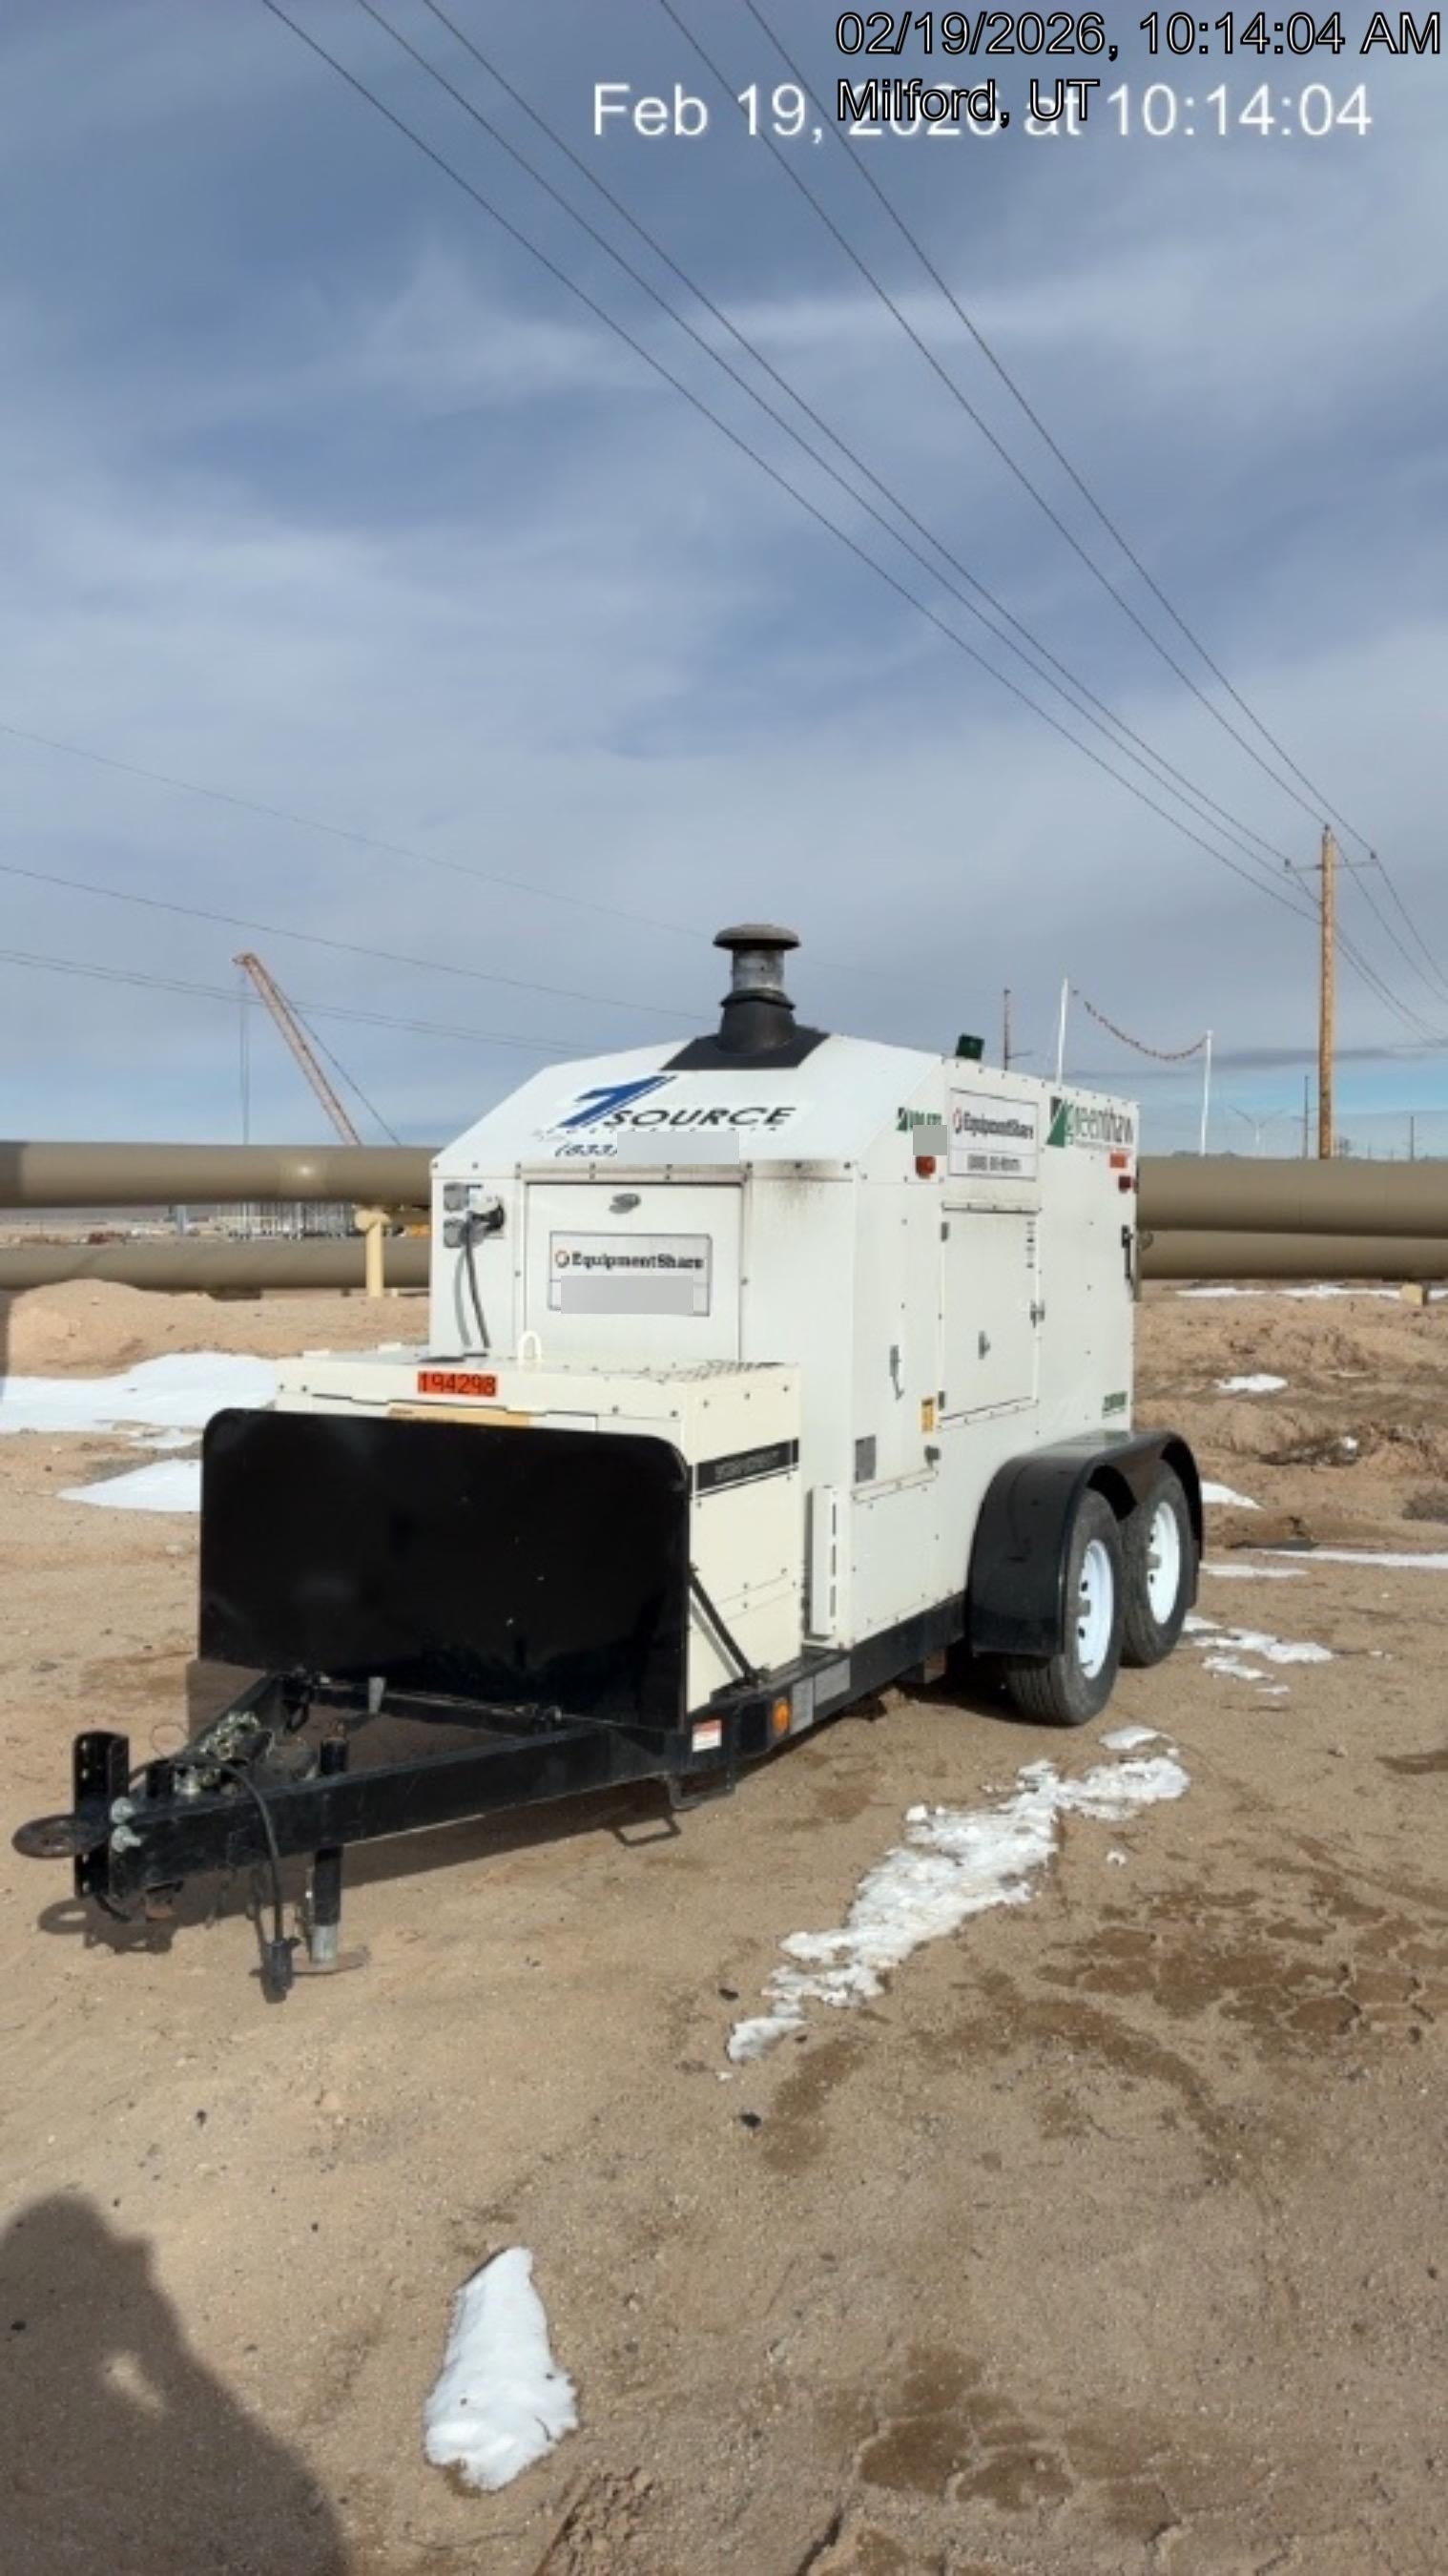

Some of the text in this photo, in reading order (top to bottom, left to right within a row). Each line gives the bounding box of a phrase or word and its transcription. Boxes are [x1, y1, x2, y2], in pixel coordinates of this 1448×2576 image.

[603, 1106, 797, 1127] SOURCE
[571, 1252, 704, 1270] EquipmentShare
[421, 1372, 495, 1396] 194298
